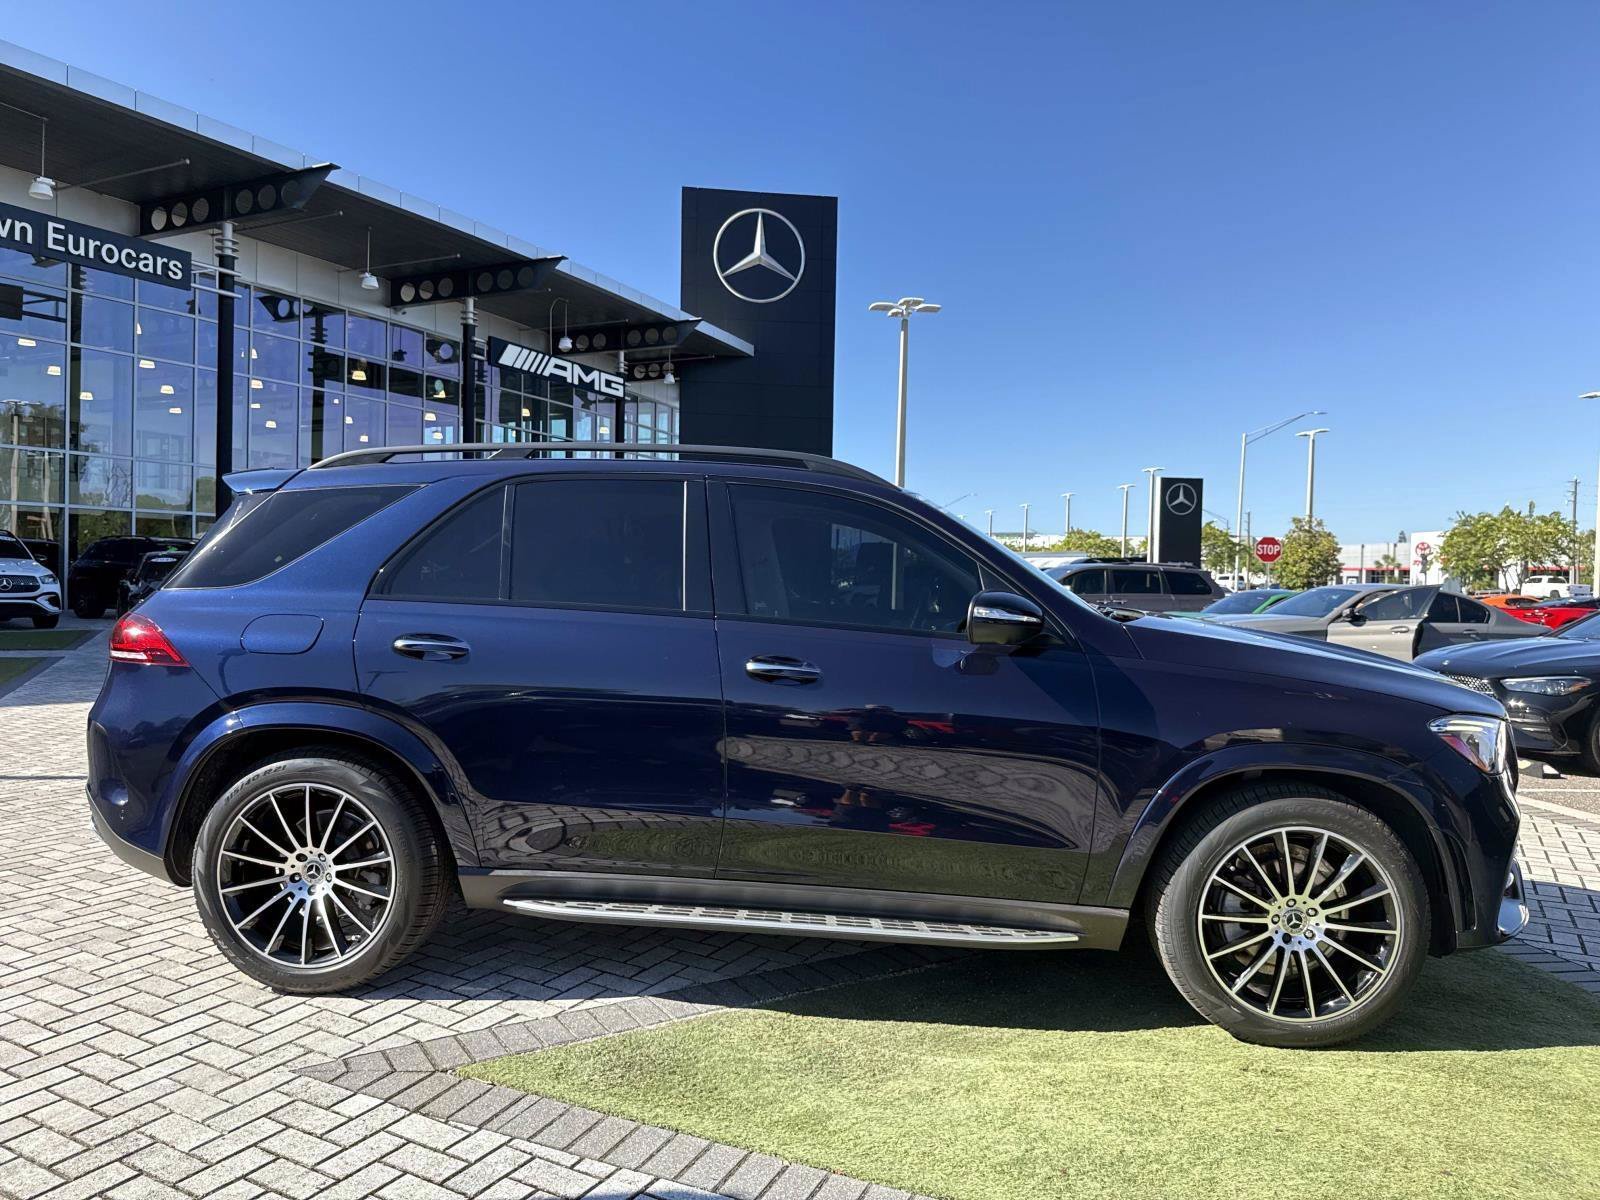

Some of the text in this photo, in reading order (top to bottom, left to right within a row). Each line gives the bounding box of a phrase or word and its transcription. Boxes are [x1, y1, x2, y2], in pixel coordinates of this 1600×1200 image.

[47, 221, 183, 280] Eurocars
[543, 356, 624, 398] AMG
[1256, 544, 1280, 555] STOP
